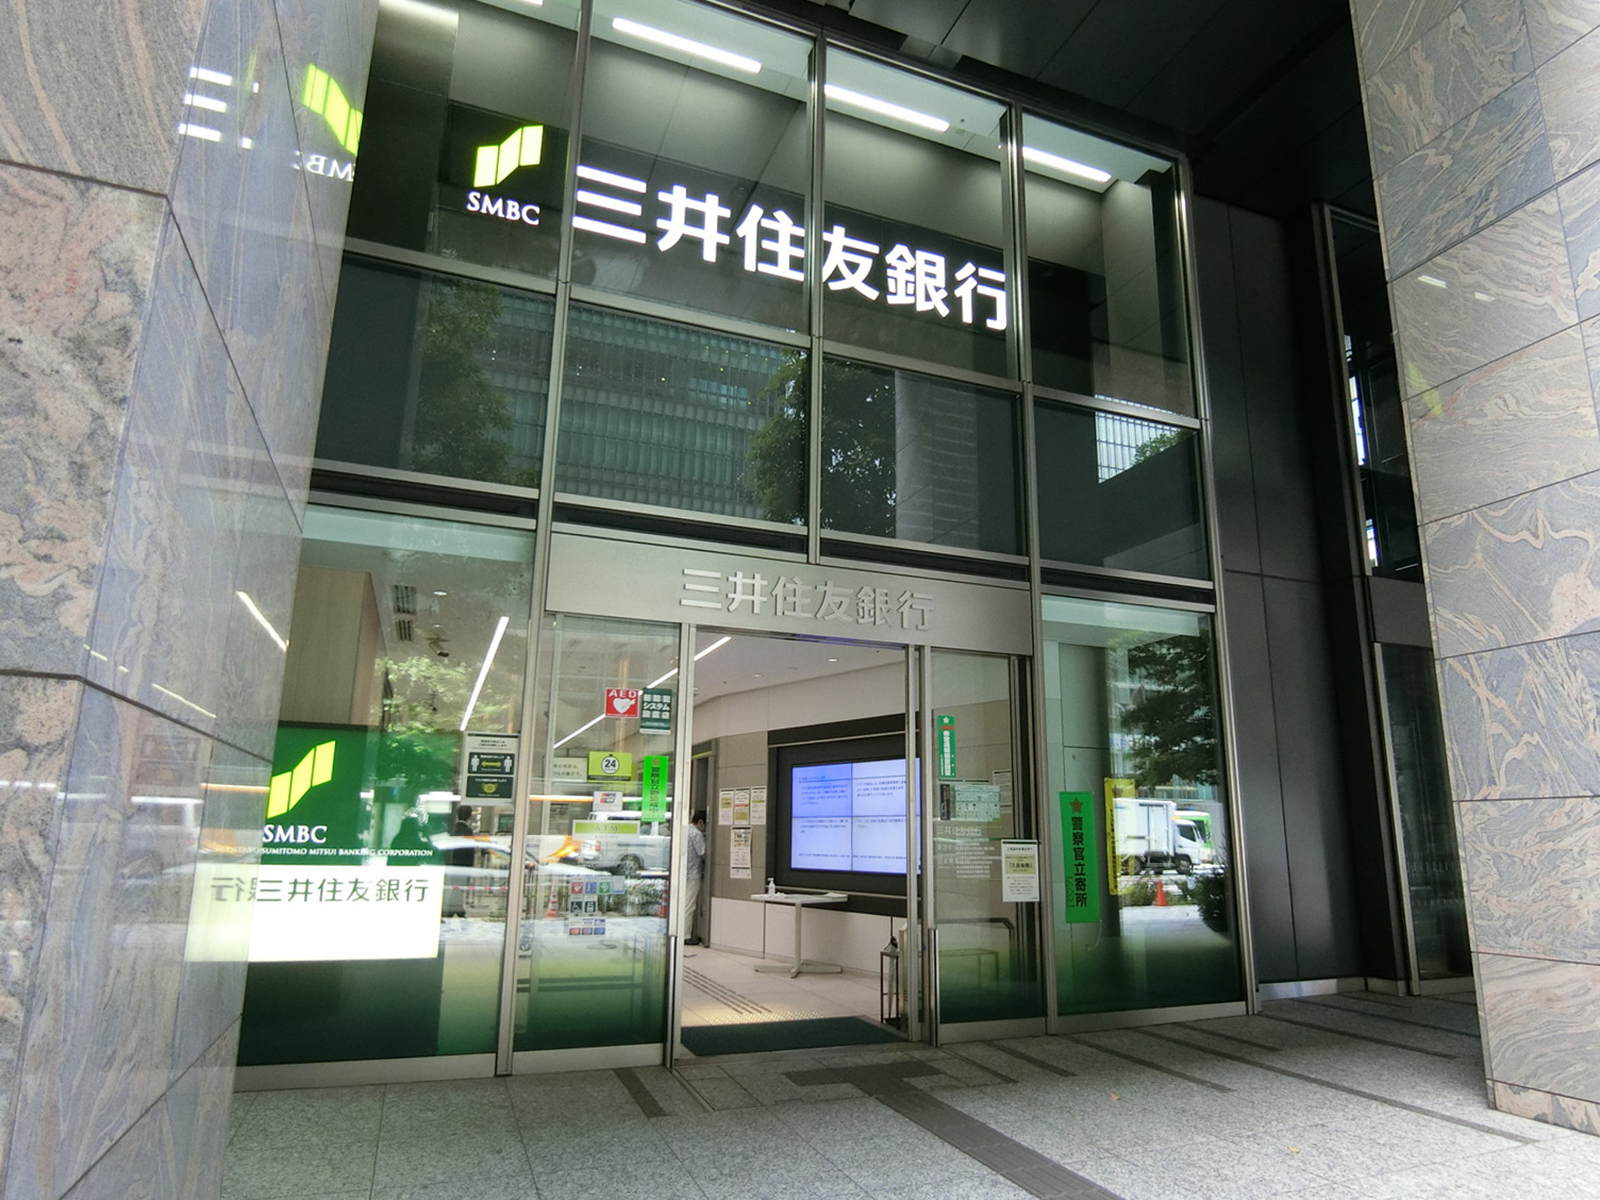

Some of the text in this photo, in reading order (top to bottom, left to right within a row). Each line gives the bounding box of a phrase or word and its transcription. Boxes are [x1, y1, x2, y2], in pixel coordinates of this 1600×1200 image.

[467, 191, 541, 227] SMBC
[571, 164, 1008, 331] 三井住友銀行
[680, 567, 935, 631] 三井住友銀行
[608, 689, 637, 698] AED
[643, 702, 671, 711] システム
[604, 759, 617, 768] 24
[262, 824, 328, 844] SMBC
[261, 847, 308, 855] SUMITOMO
[308, 848, 337, 856] MITSUI
[338, 848, 376, 857] BANKING
[377, 848, 434, 857] CORPORATION
[1071, 816, 1088, 907] 警察官立寄所
[256, 877, 430, 903] 三井住友銀行
